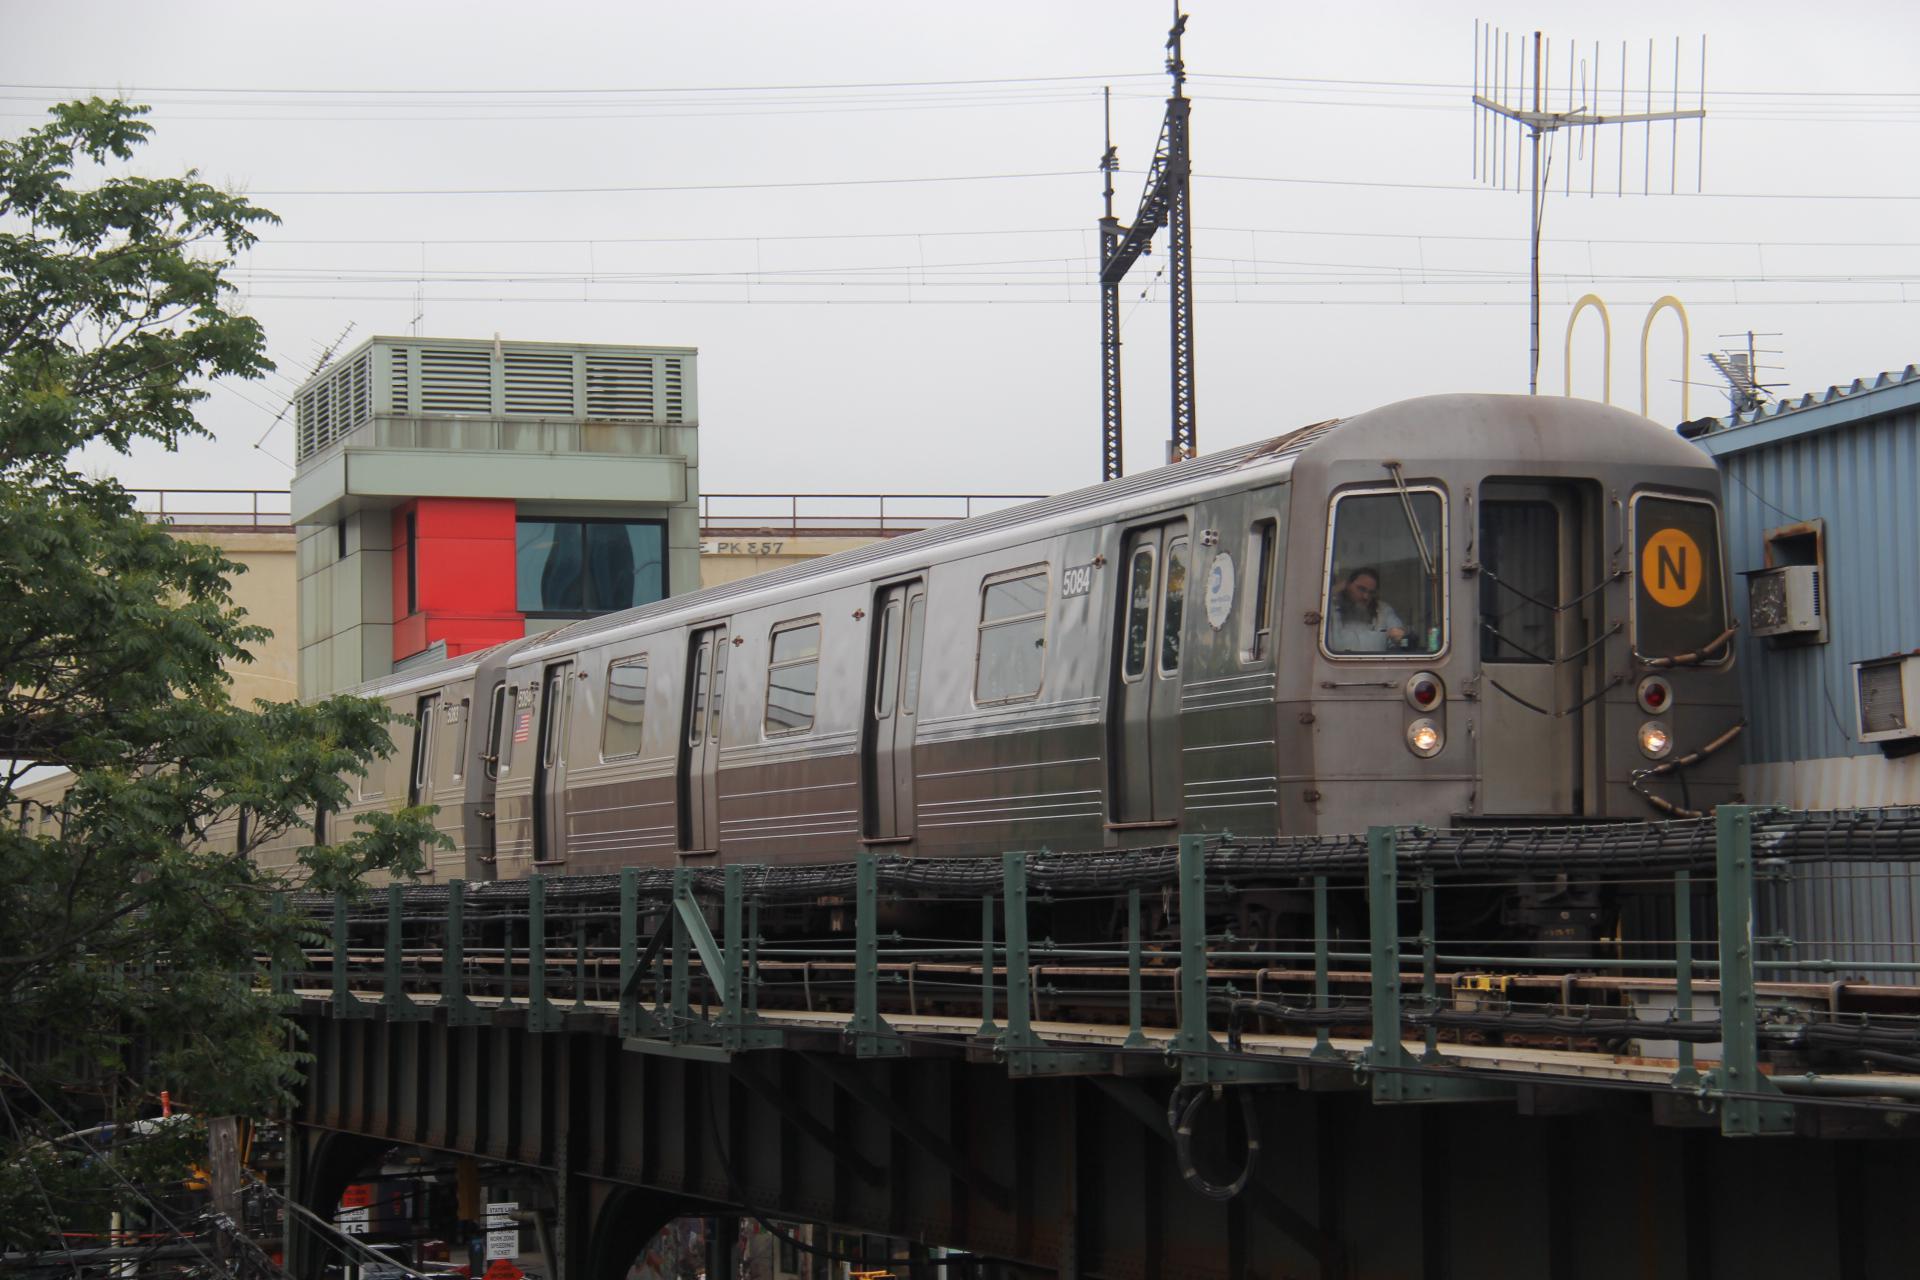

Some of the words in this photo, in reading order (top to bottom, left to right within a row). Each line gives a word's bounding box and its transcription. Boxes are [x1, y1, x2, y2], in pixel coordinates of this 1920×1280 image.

[717, 542, 741, 553] PK
[1658, 545, 1686, 590] N
[1063, 566, 1091, 596] 5084
[345, 1224, 363, 1234] 15
